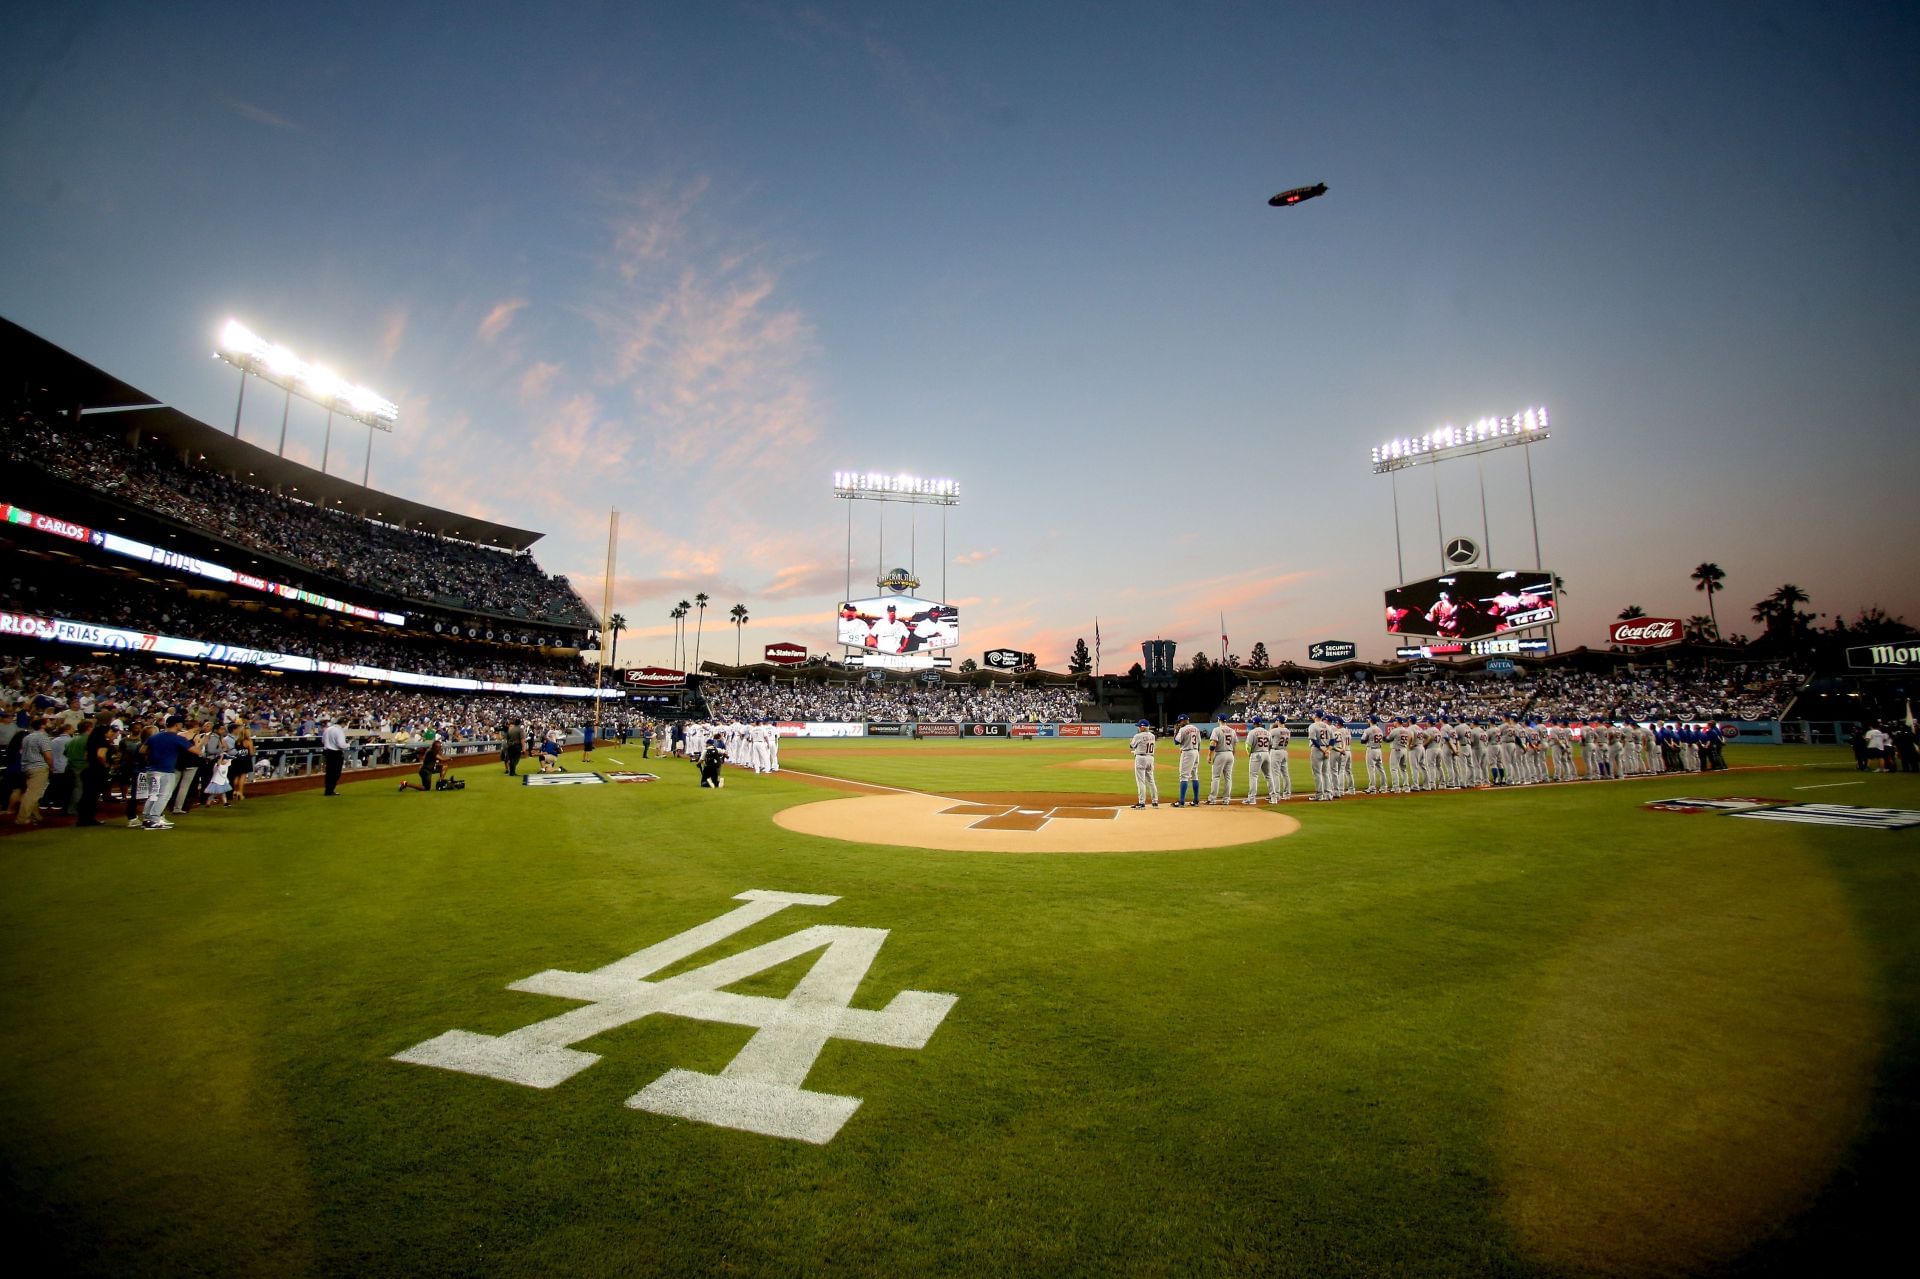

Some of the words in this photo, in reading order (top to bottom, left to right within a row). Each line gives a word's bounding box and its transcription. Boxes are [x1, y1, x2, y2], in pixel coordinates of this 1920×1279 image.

[36, 516, 84, 539] CARLOS
[239, 575, 264, 589] CARLOS
[58, 624, 100, 641] FRIAS
[1614, 621, 1677, 641] Coca-Cola
[141, 634, 158, 650] 77
[627, 670, 685, 681] Budweiser
[985, 725, 998, 735] LG
[1320, 730, 1328, 740] 21
[1191, 734, 1197, 745] 3
[1225, 734, 1232, 746] 5
[1257, 736, 1269, 748] 52
[1373, 734, 1382, 744] 62
[1145, 742, 1154, 754] 10
[390, 888, 960, 1146] LA
